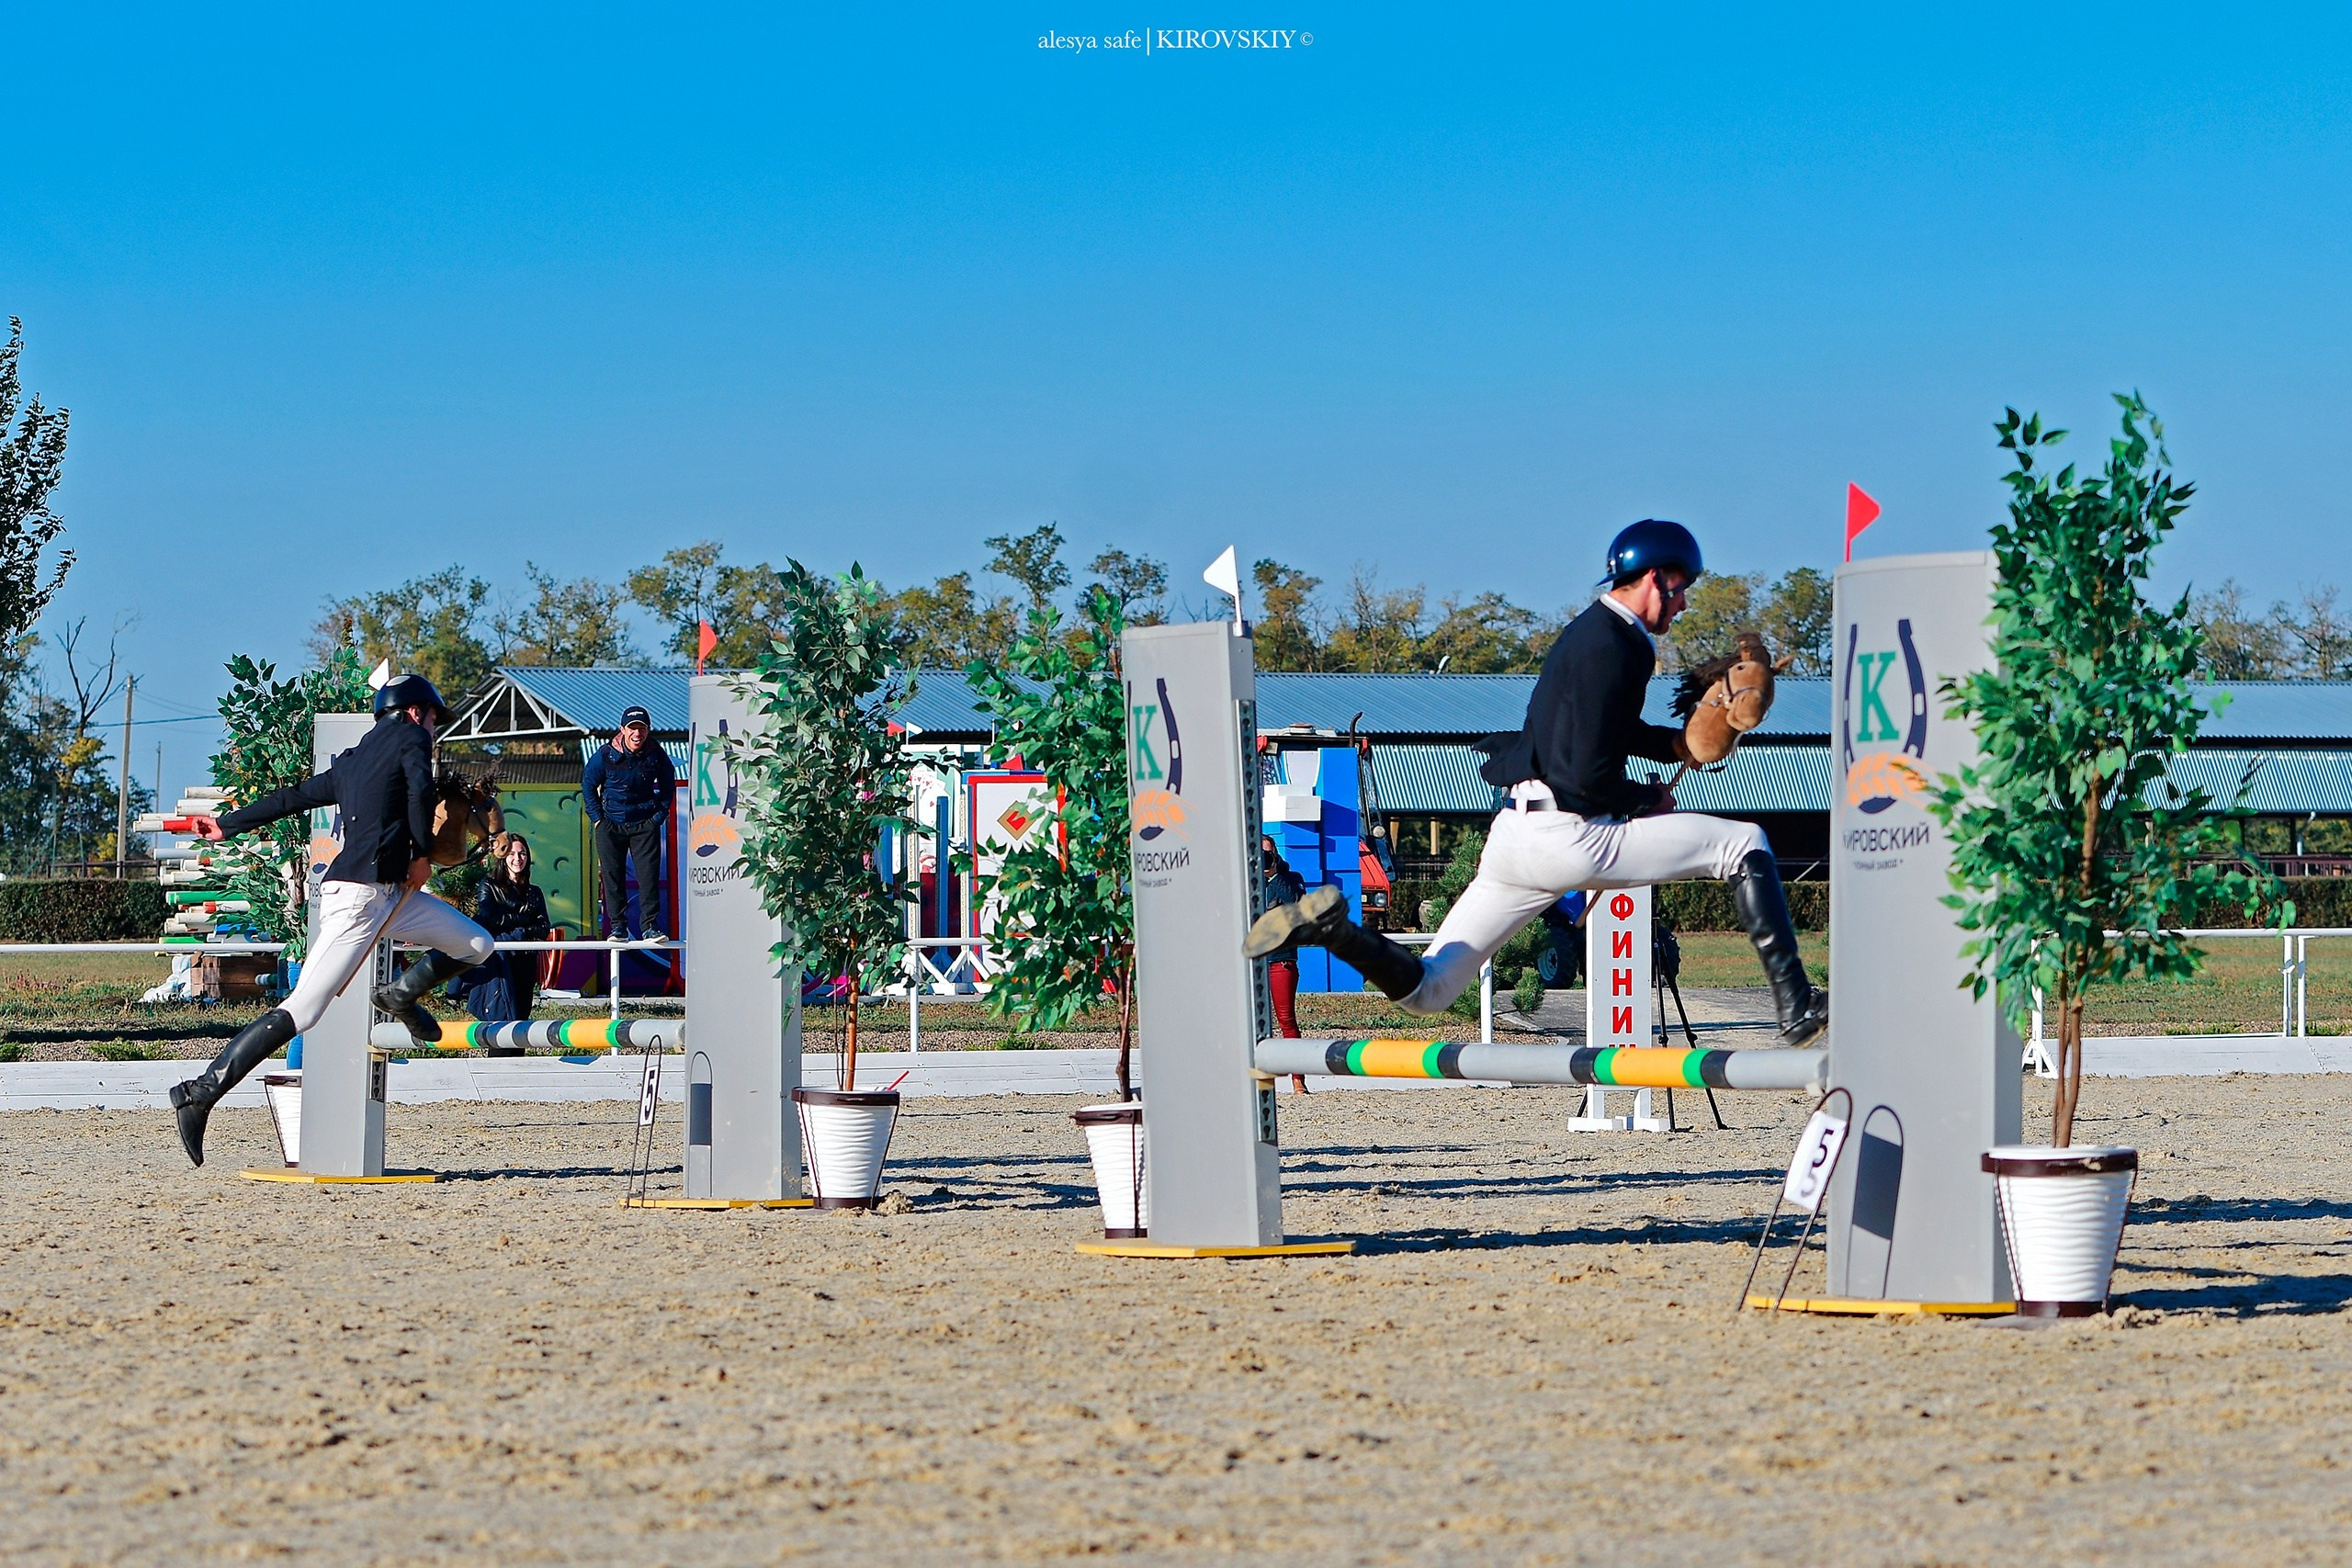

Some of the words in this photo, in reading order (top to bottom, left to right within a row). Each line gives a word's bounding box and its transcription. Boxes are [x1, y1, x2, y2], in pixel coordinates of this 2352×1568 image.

[1857, 650, 1900, 742] К
[1132, 705, 1163, 780] К
[1842, 821, 1929, 852] ИРОВСКИЙ
[1609, 893, 1637, 1048] ФИНИ
[644, 1069, 655, 1121] 5
[1812, 1128, 1835, 1168] 5
